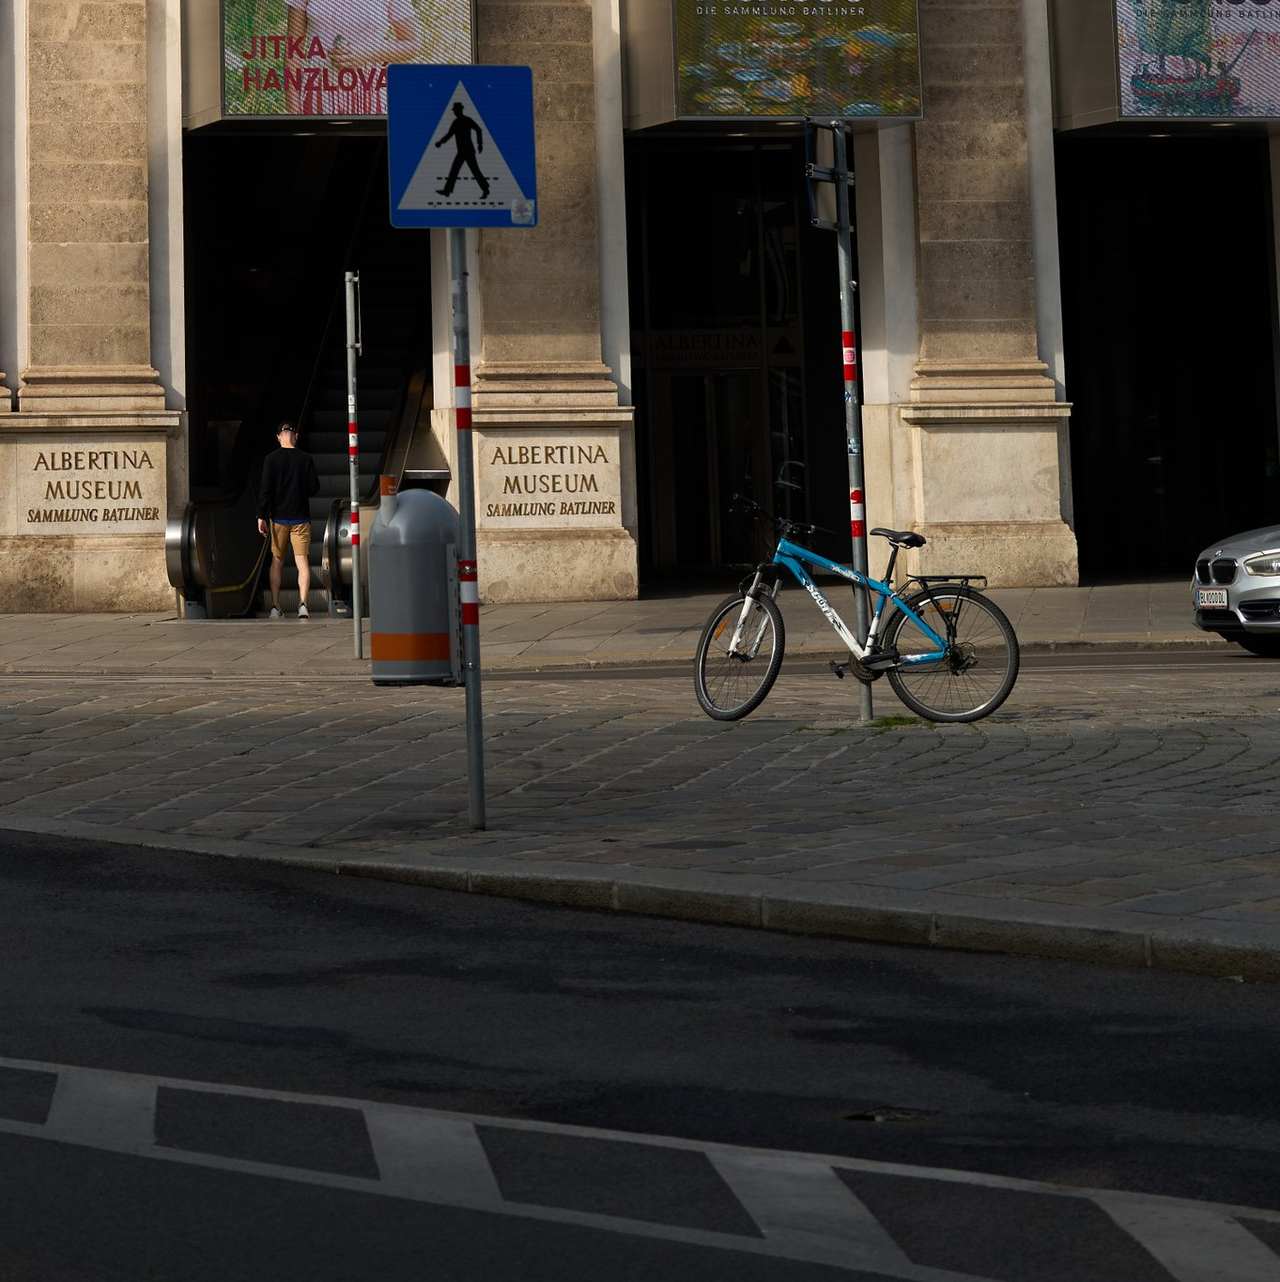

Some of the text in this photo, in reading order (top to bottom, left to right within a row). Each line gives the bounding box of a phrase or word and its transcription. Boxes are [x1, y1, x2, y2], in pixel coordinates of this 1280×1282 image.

[696, 6, 865, 16] DIE SAMMLUNG BATLINER
[242, 35, 326, 60] JITKA
[654, 333, 759, 351] ALBERTINA
[33, 450, 154, 471] ALBERTINA
[490, 445, 609, 465] ALBERTINA
[44, 480, 143, 500] MUSEUM
[503, 474, 599, 494] MUSEUM
[27, 507, 160, 523] SAMMLUNG BATLINER
[486, 501, 616, 517] SAMMLUNG BATLINER
